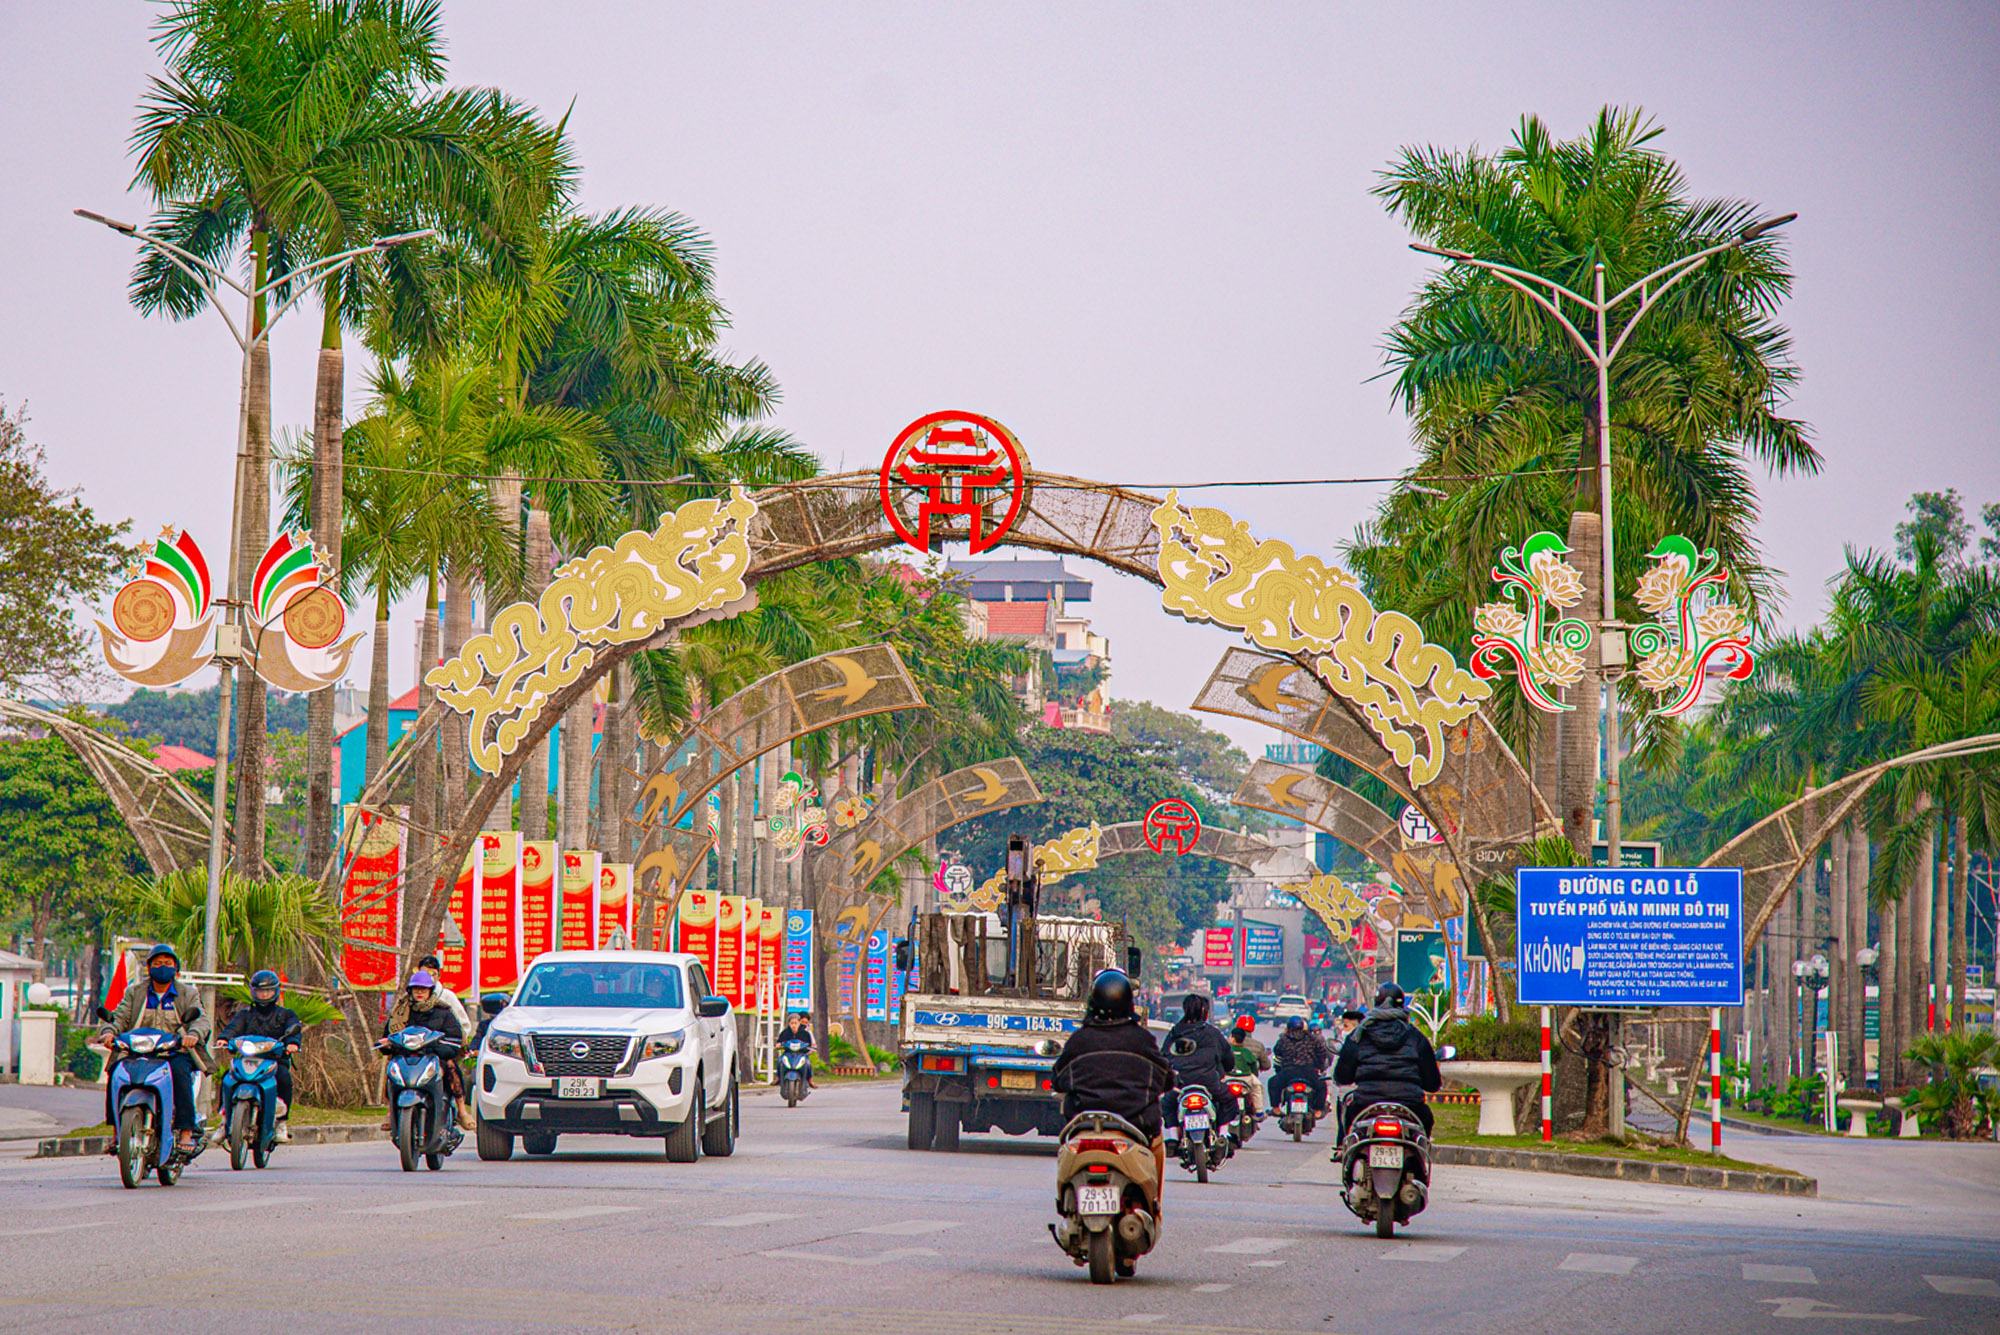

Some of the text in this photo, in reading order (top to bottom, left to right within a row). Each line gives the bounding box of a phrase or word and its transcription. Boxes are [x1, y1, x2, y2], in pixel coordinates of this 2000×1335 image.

[1476, 850, 1506, 862] BIDV
[1558, 873, 1698, 896] ĐƯỜNG CAO LỖ
[1530, 898, 1729, 919] TUYẾN PHỐ VĂN MINH ĐÔ THỊ
[1524, 936, 1570, 974] KHÔNG
[986, 1014, 1008, 1030] 99C
[1025, 1016, 1062, 1032] 164.35
[570, 1078, 588, 1087] 29K
[563, 1088, 595, 1096] 099.23
[1085, 1188, 1112, 1200] 29-S1
[1082, 1200, 1117, 1212] 701.10
